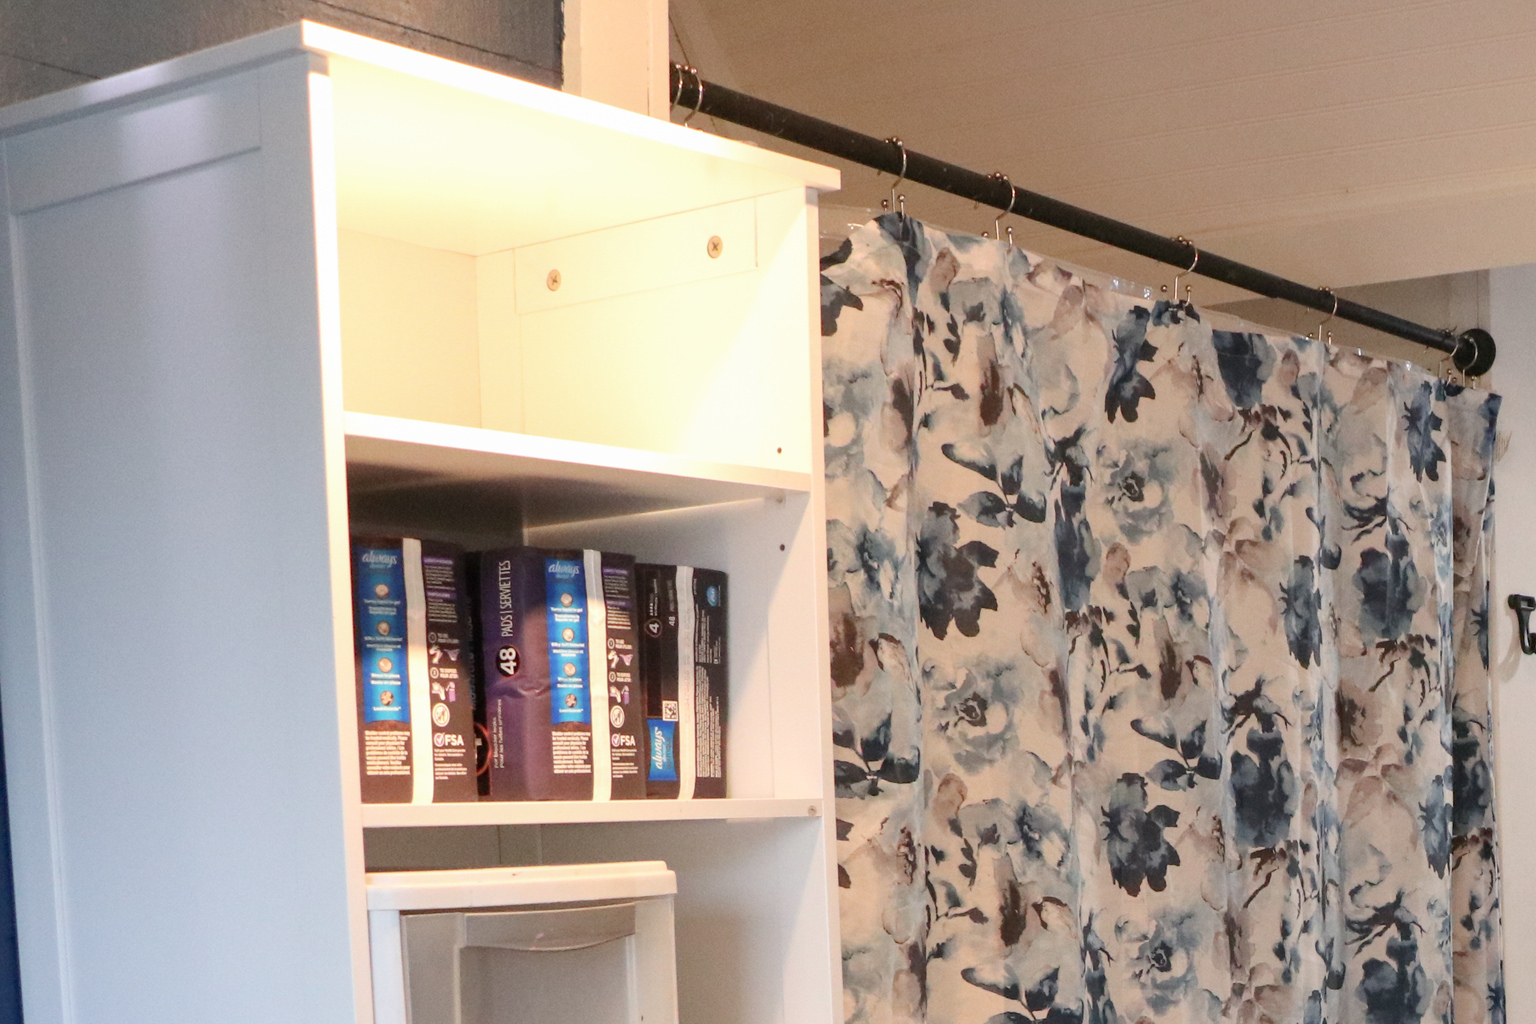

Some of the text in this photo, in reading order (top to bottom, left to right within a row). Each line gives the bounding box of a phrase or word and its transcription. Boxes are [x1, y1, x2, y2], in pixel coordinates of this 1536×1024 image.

[361, 550, 398, 568] always
[548, 560, 580, 577] always
[498, 560, 517, 675] 48 PADS SERVIETTES
[668, 616, 676, 627] 48
[649, 622, 660, 634] 4
[445, 734, 465, 746] FSA
[620, 735, 636, 746] FSA
[652, 728, 666, 770] always
